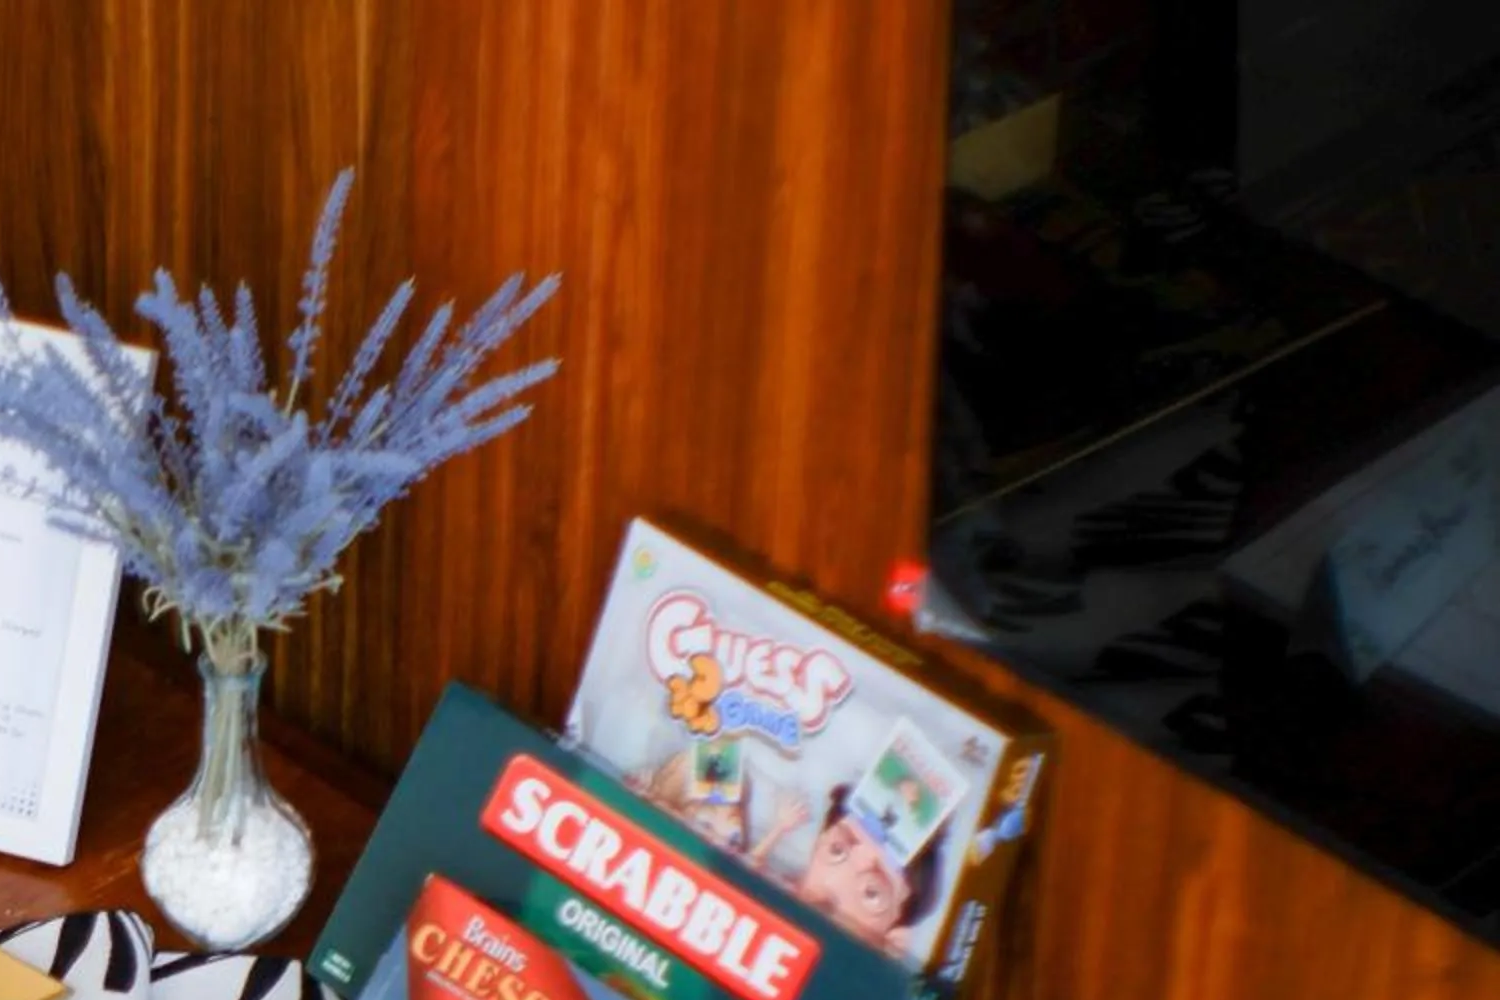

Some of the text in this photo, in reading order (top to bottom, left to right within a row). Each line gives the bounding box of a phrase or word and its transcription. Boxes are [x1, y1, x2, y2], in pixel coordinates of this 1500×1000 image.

[646, 587, 855, 735] GUESS
[463, 913, 528, 974] Brains
[500, 776, 802, 1000] SCRABBLE
[556, 895, 675, 990] ORIGINAL
